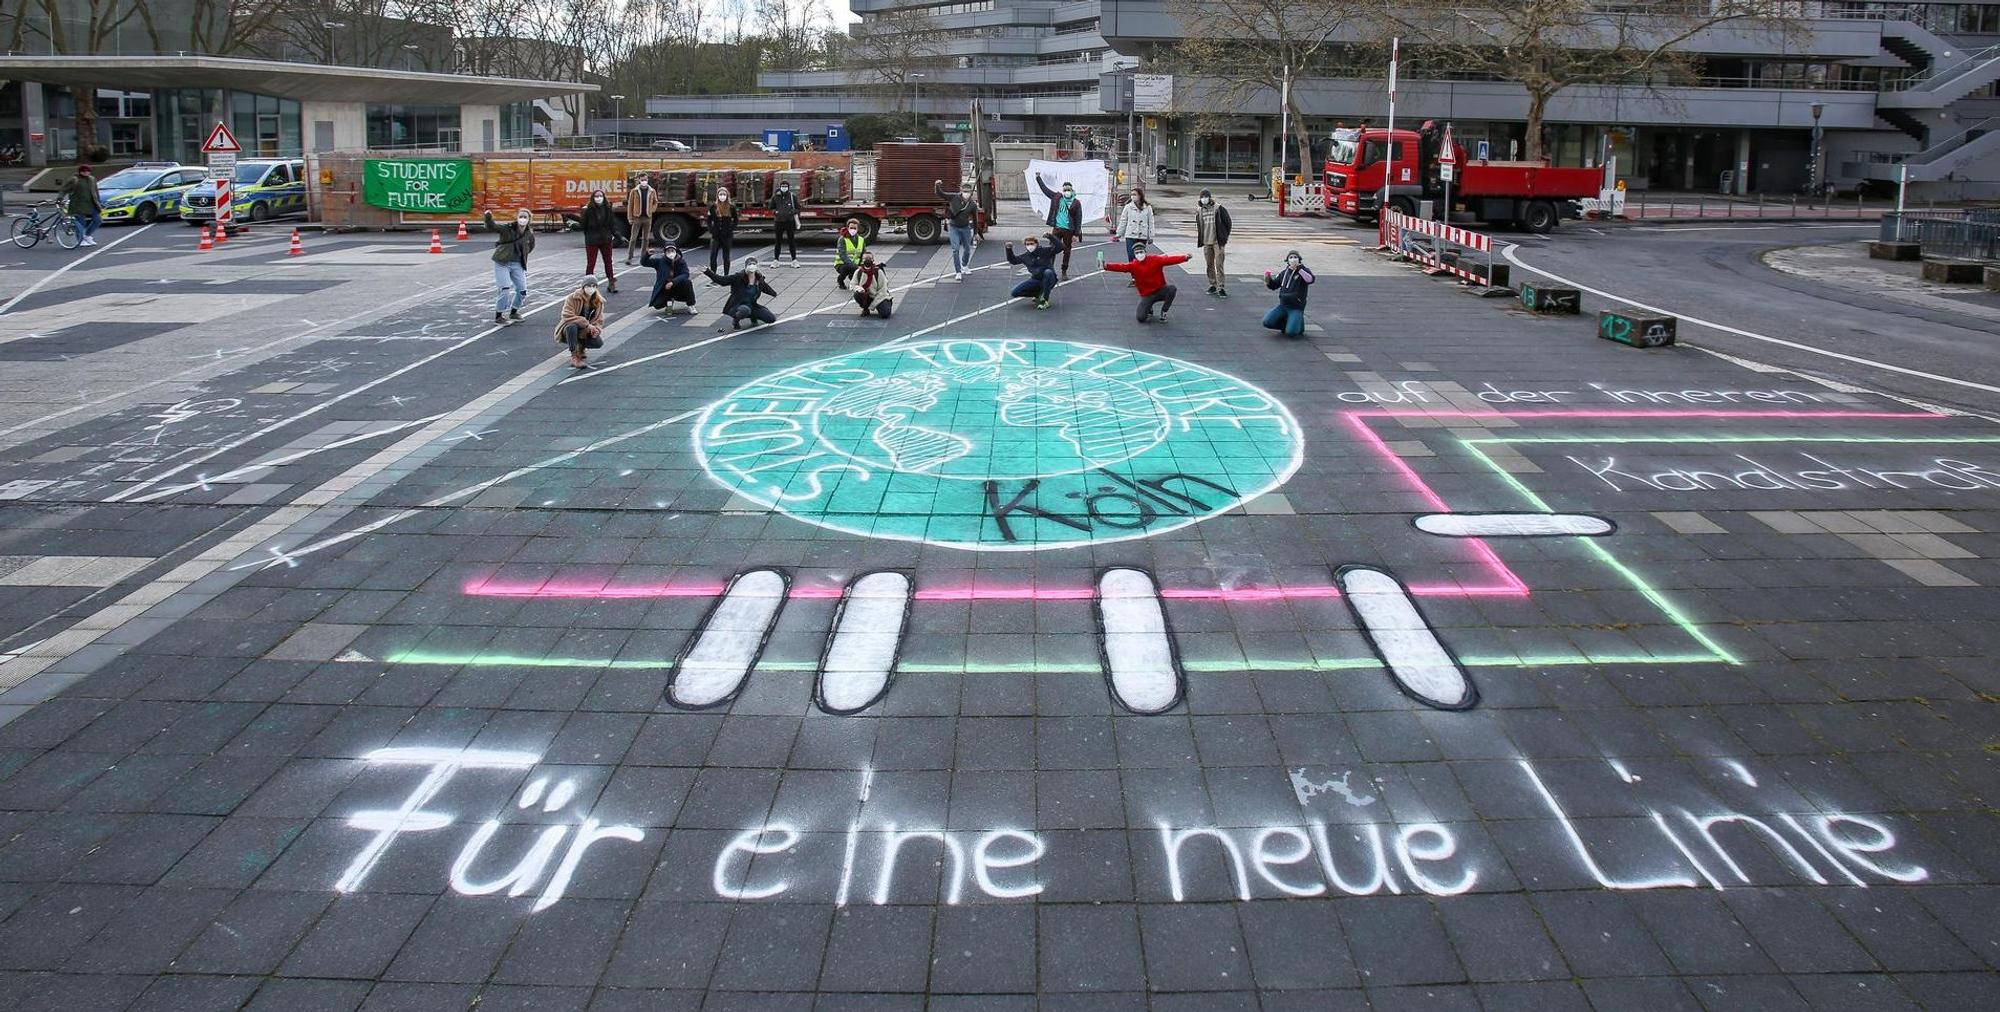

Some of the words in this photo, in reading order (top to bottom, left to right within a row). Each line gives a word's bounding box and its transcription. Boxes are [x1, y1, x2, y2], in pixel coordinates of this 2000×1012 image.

[378, 162, 457, 180] STUDENTS
[405, 180, 429, 192] FOR
[565, 179, 628, 193] DANKE!
[388, 191, 447, 208] FUTURE
[1601, 314, 1634, 345] 12
[1337, 381, 1429, 404] auf
[1477, 382, 1574, 403] der
[1586, 382, 1824, 404] inneren
[706, 360, 875, 502] STUDENTS
[883, 339, 1030, 368] FOR
[1058, 344, 1289, 436] FUTURE
[984, 466, 1243, 542] Köln
[335, 746, 646, 914] Für
[712, 764, 1046, 908] eine
[1157, 818, 1479, 904] neue
[1517, 756, 1932, 894] Linie
